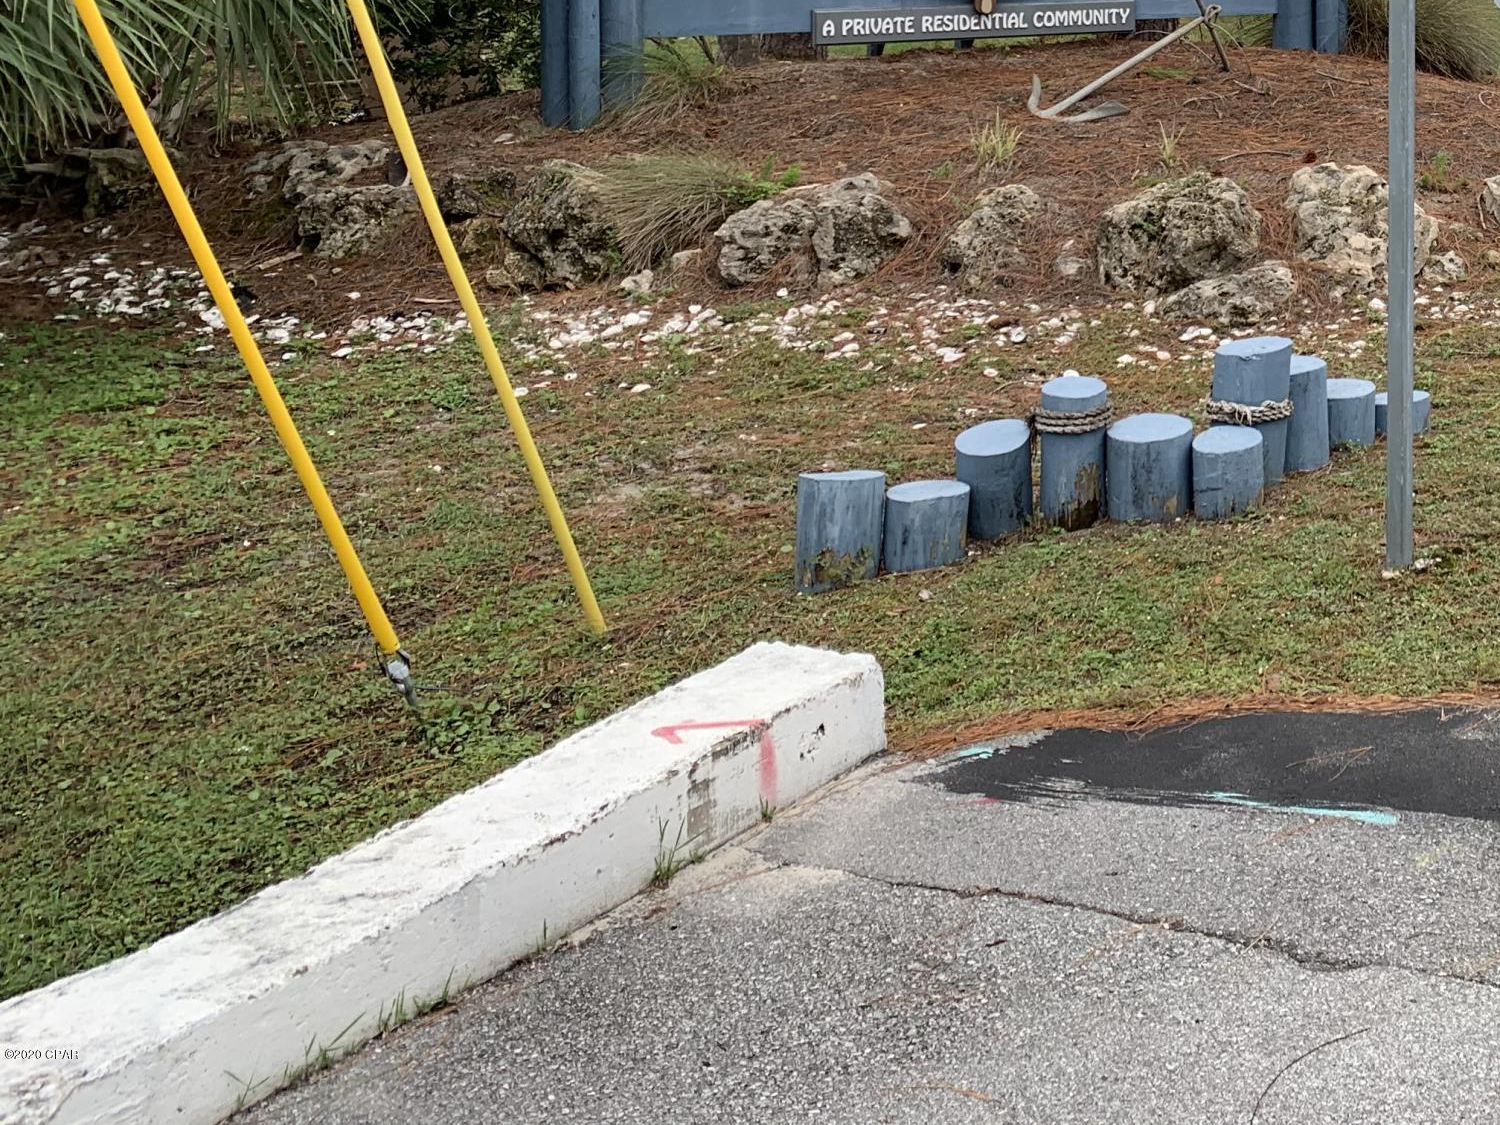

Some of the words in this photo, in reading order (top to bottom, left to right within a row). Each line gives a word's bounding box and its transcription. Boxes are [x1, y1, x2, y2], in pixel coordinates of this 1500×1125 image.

[822, 19, 836, 37] A
[841, 16, 916, 36] PRIVATE
[921, 11, 1028, 33] RESIDENTIAL
[1033, 7, 1131, 28] COMMUNITY
